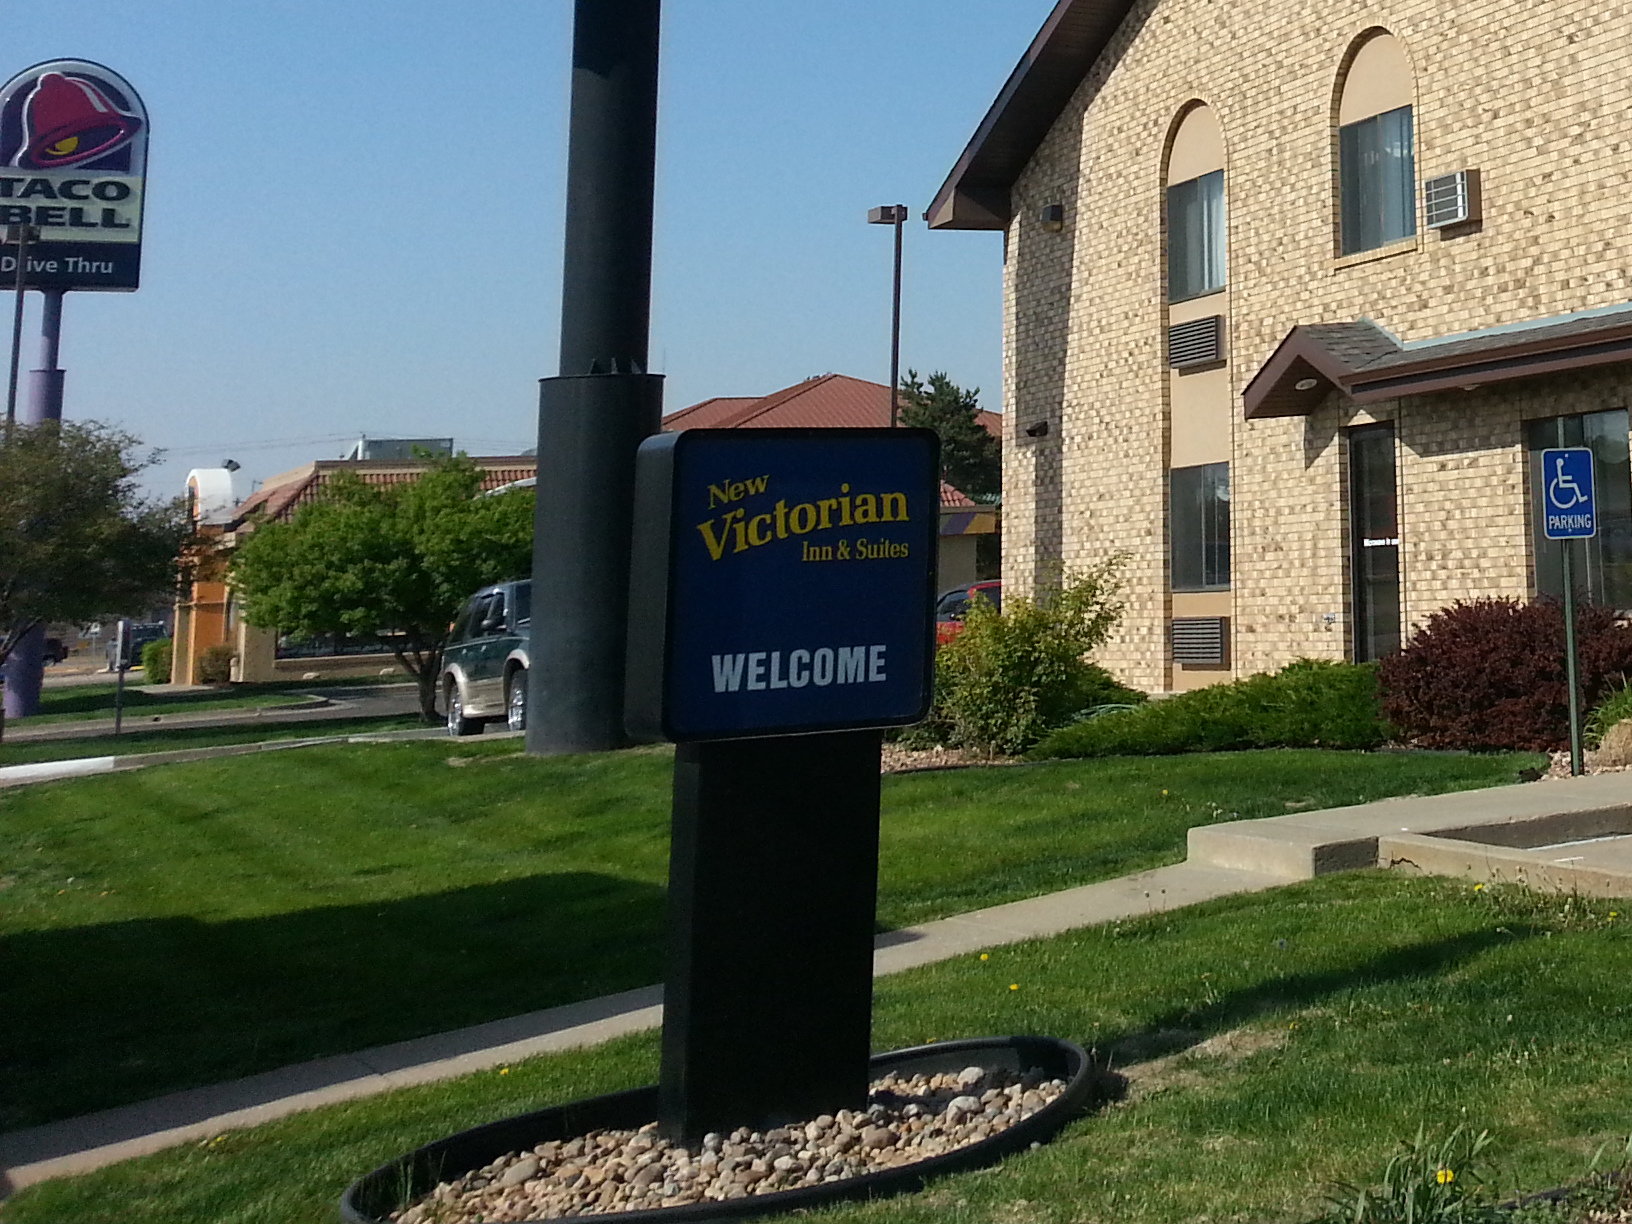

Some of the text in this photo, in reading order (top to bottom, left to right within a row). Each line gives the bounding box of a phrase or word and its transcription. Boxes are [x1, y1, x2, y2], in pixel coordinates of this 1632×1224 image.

[0, 178, 130, 201] TACO
[0, 205, 130, 228] BELL
[1, 256, 113, 274] Dive Thru
[707, 475, 769, 510] New
[697, 483, 909, 561] Victorian
[1549, 514, 1591, 529] PARKING
[801, 538, 909, 562] Inn & Suites
[711, 645, 886, 693] WELCOME
